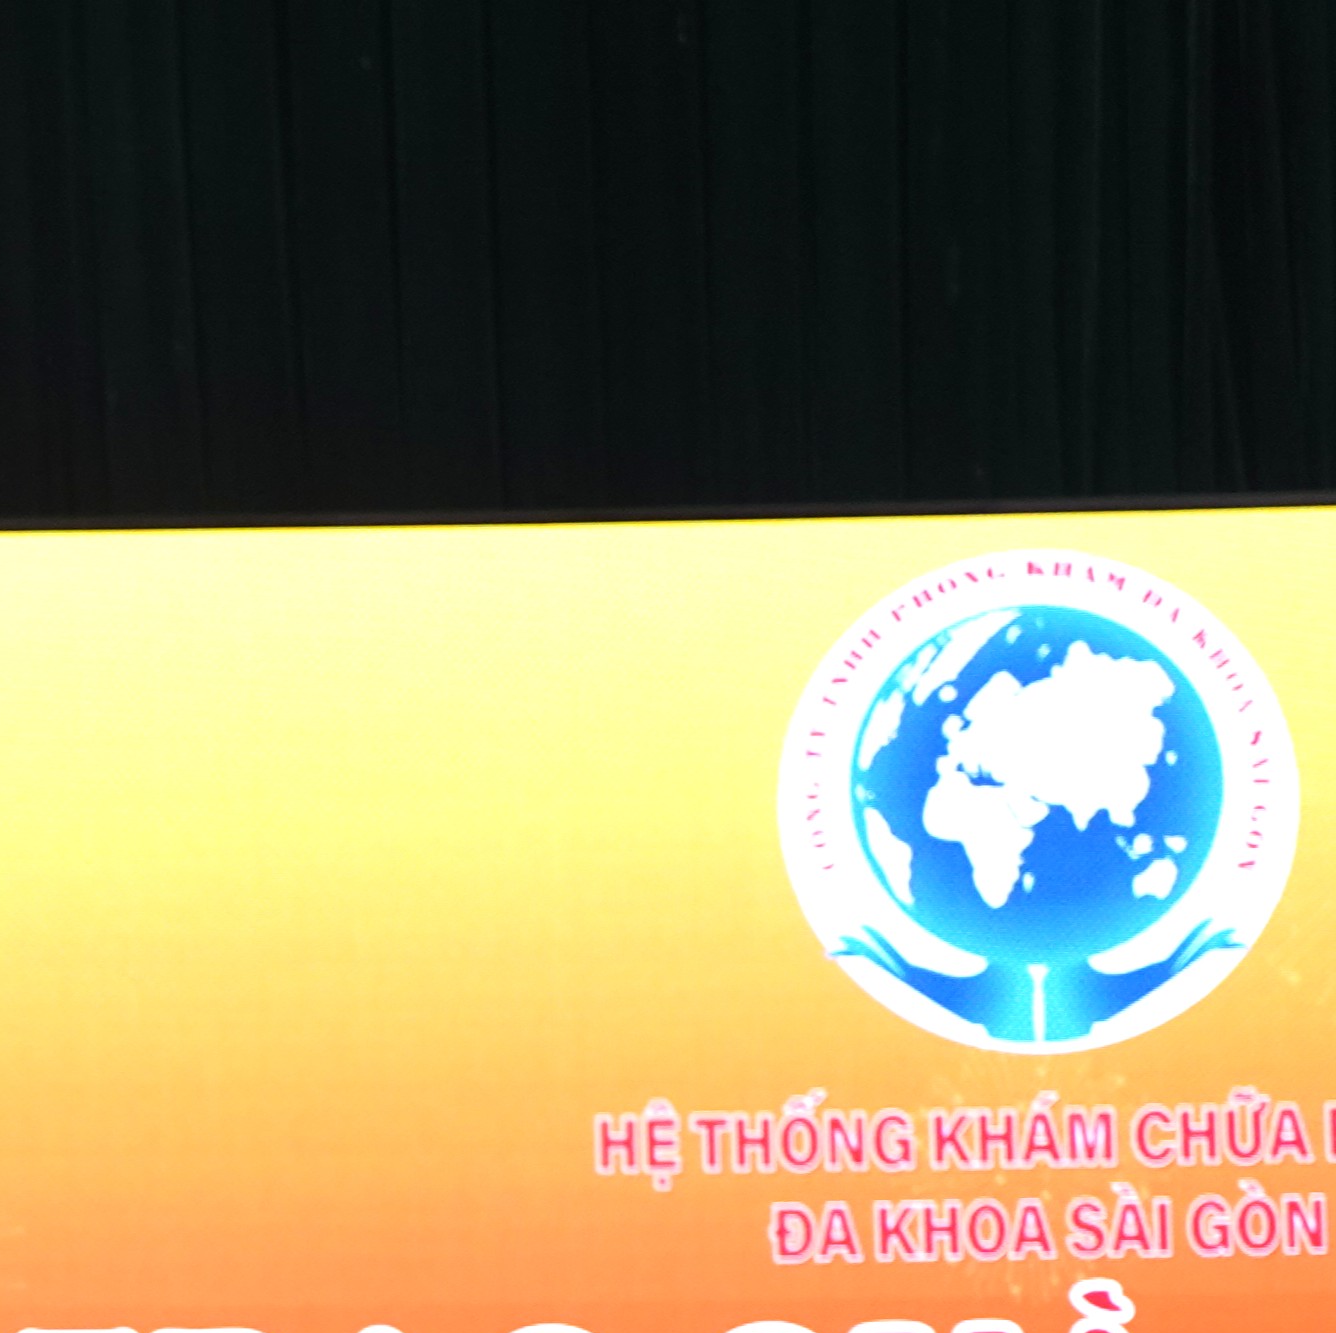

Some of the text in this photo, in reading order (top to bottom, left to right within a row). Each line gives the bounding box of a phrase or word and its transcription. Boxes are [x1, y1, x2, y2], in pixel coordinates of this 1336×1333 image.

[594, 1097, 683, 1192] HỆ
[690, 1087, 919, 1176] THỐNG
[928, 1090, 1119, 1173] KHÁM
[1130, 1085, 1316, 1169] CHỮA
[768, 1177, 1330, 1265] ĐA KHOA SÀI GÒN
